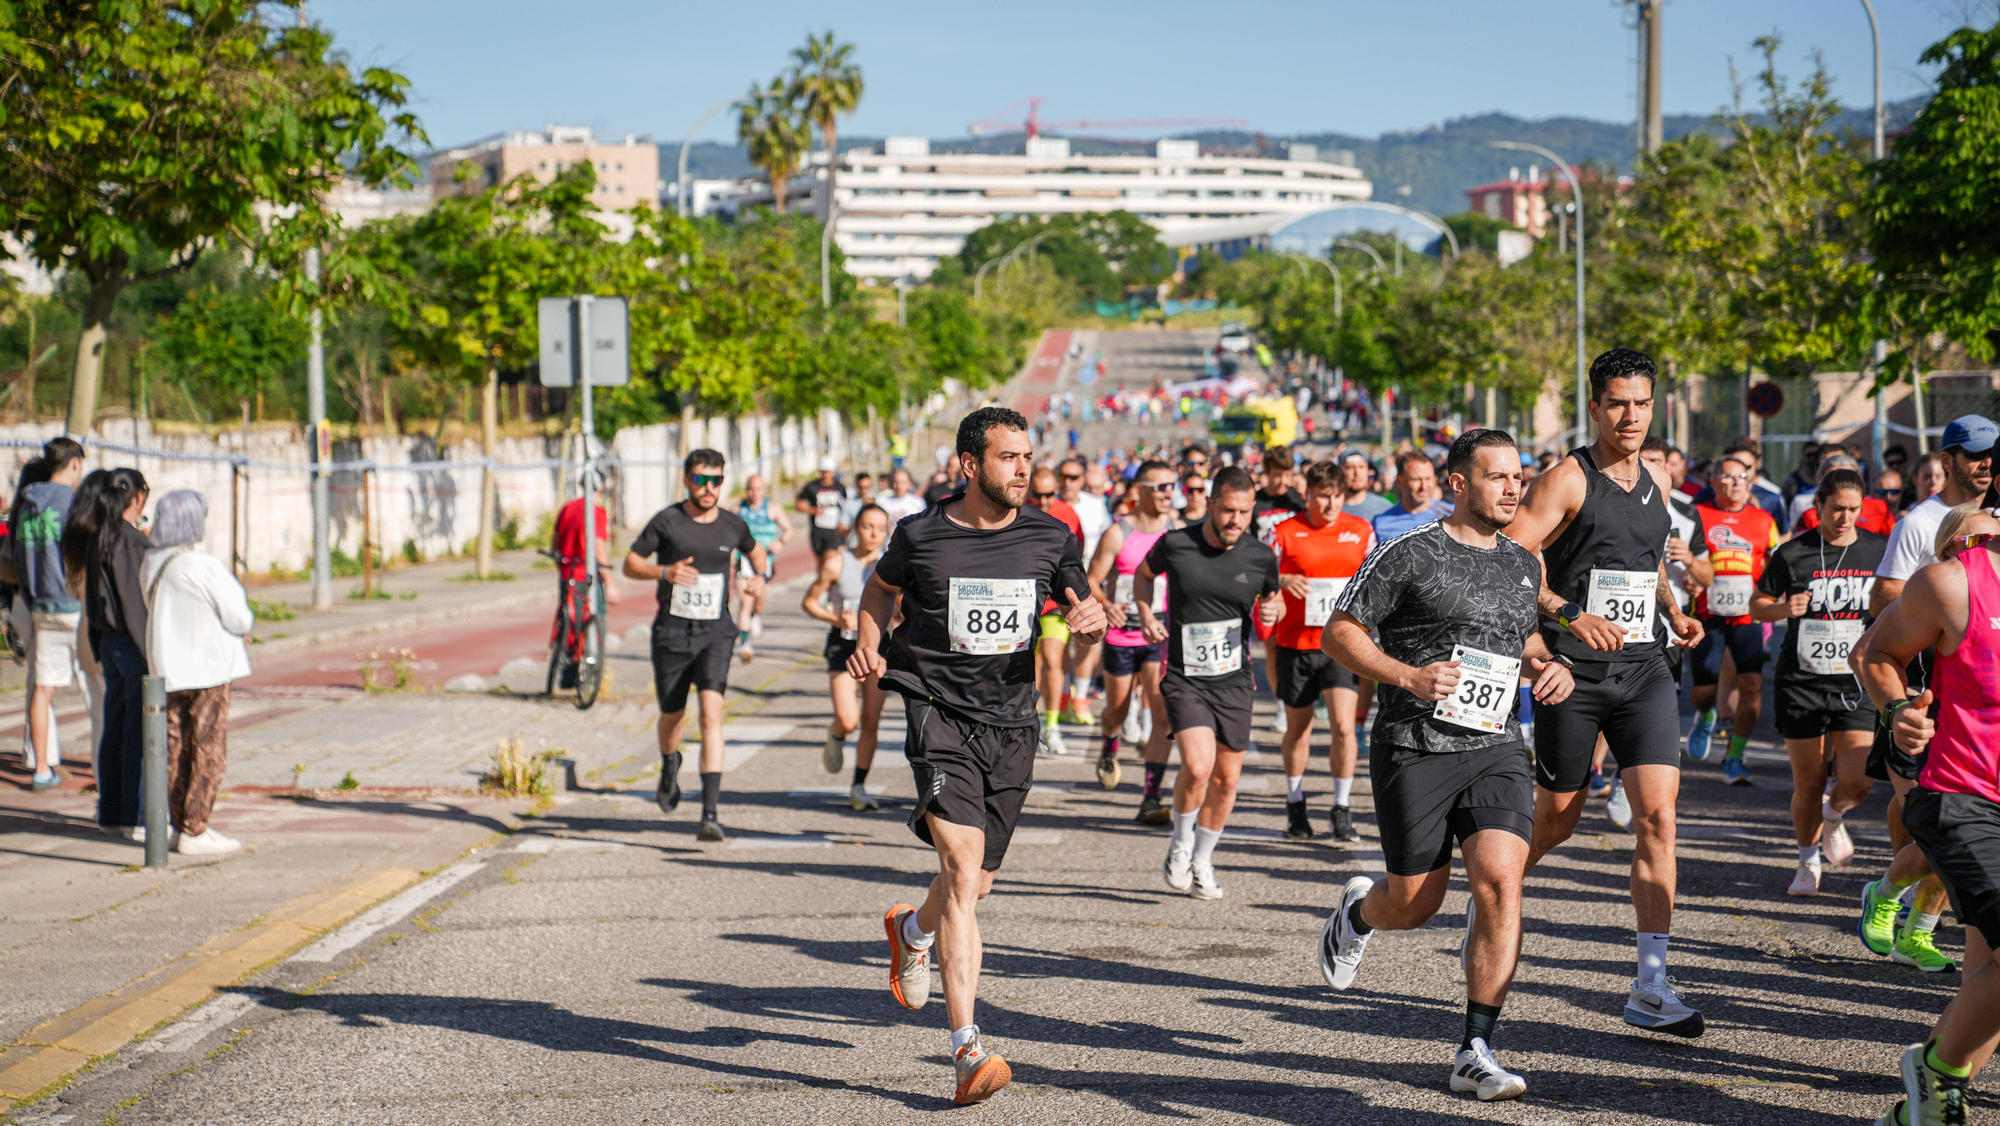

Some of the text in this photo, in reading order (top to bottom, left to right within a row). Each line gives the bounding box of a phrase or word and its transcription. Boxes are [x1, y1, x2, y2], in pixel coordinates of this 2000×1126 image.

[1597, 579, 1630, 587] populares
[1812, 568, 1860, 578] CORDOBA
[681, 591, 712, 607] 333
[957, 588, 994, 597] populares
[1716, 592, 1744, 605] 283
[1808, 575, 1876, 612] 10K
[1604, 598, 1645, 623] 394
[967, 609, 1020, 634] 884
[1196, 641, 1232, 662] 315
[1810, 641, 1849, 660] 298
[1458, 679, 1506, 711] 387
[1916, 1065, 1929, 1102] HOKA
